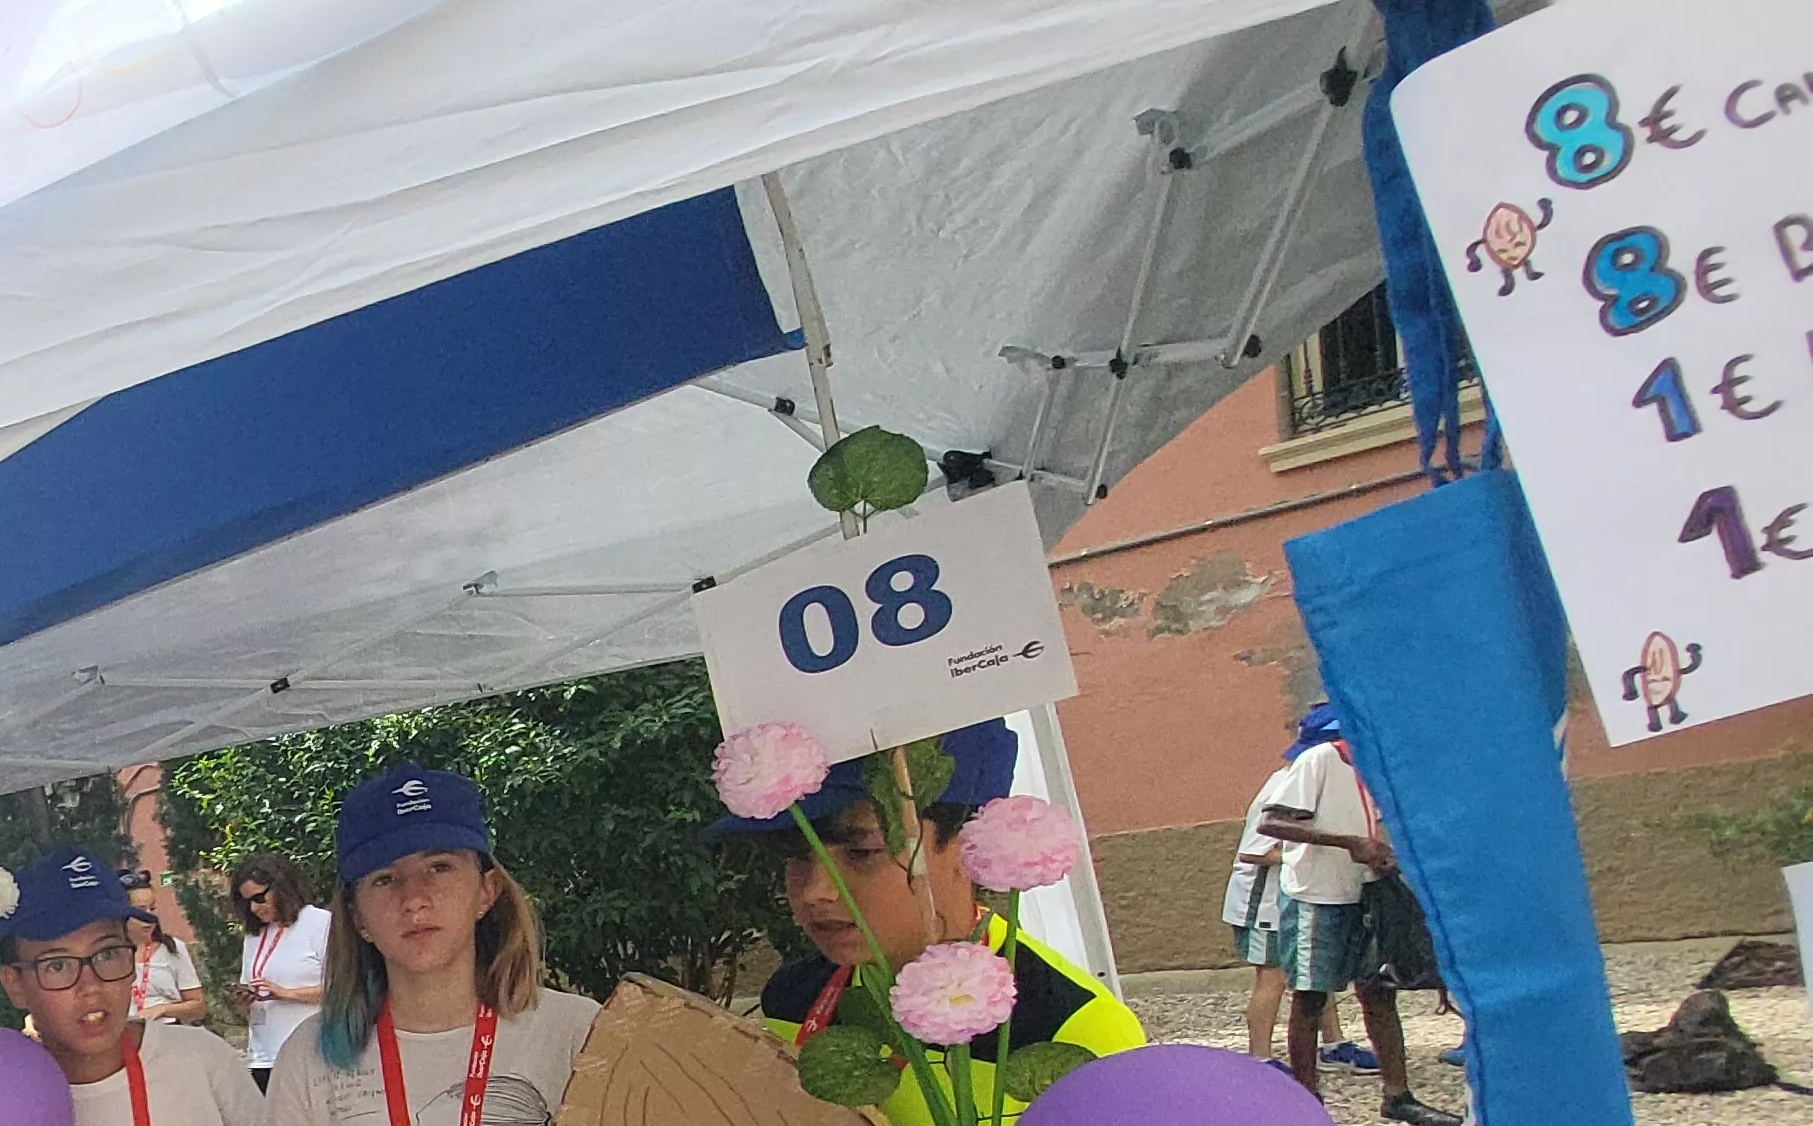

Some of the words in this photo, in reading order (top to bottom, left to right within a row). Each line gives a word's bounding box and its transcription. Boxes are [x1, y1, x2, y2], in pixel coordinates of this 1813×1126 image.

[1724, 72, 1813, 129] CA
[1632, 355, 1784, 442] 1€
[779, 554, 953, 674] 08
[948, 644, 1004, 667] Fundación
